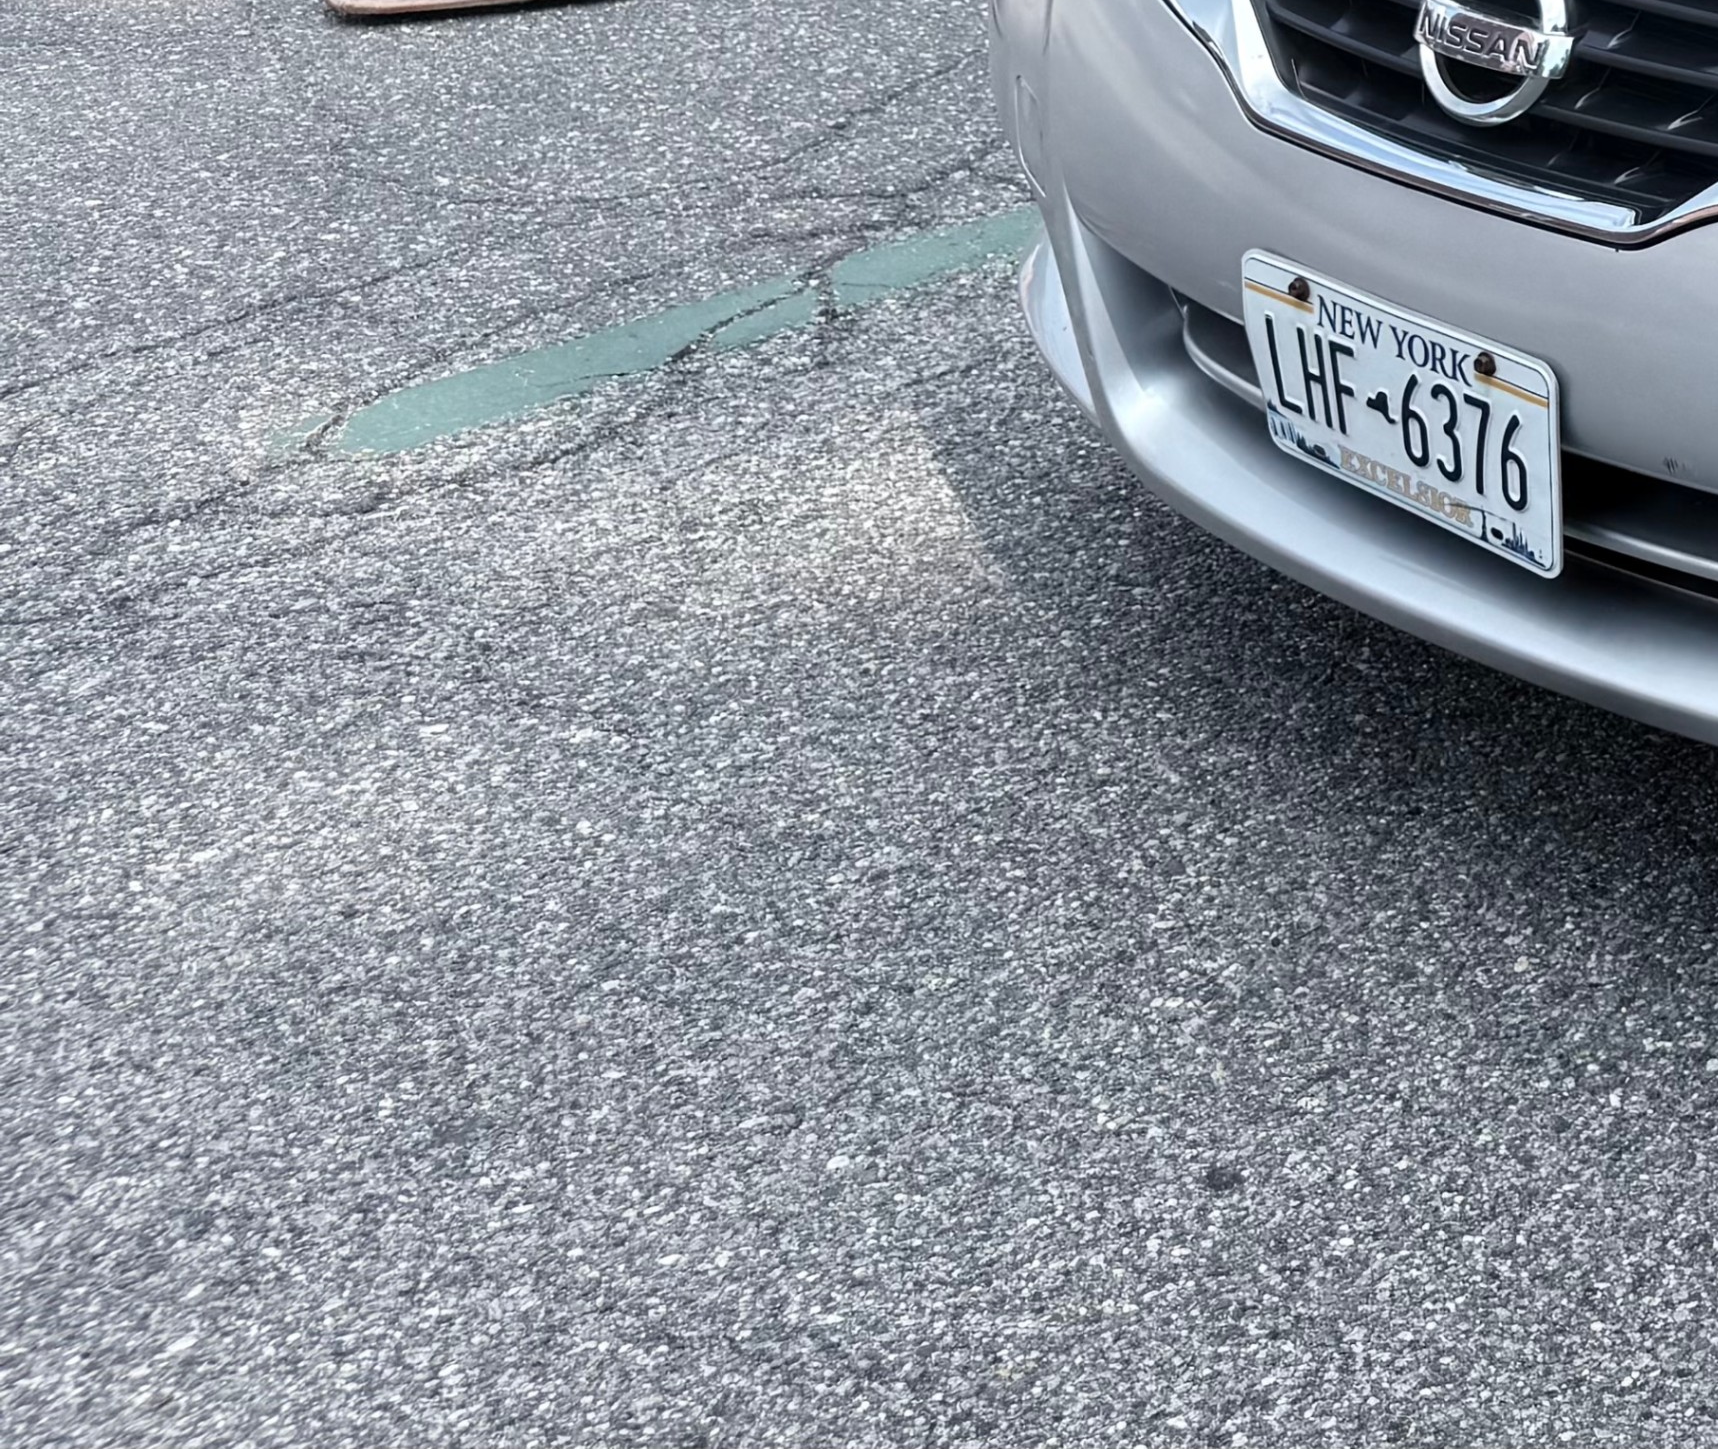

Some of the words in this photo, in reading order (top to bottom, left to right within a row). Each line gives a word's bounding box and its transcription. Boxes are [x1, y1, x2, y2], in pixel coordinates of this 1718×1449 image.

[1418, 5, 1543, 71] NISSAN
[1317, 295, 1383, 349] NEW
[1389, 324, 1472, 387] YORK
[1338, 445, 1474, 528] EXCELSIOR
